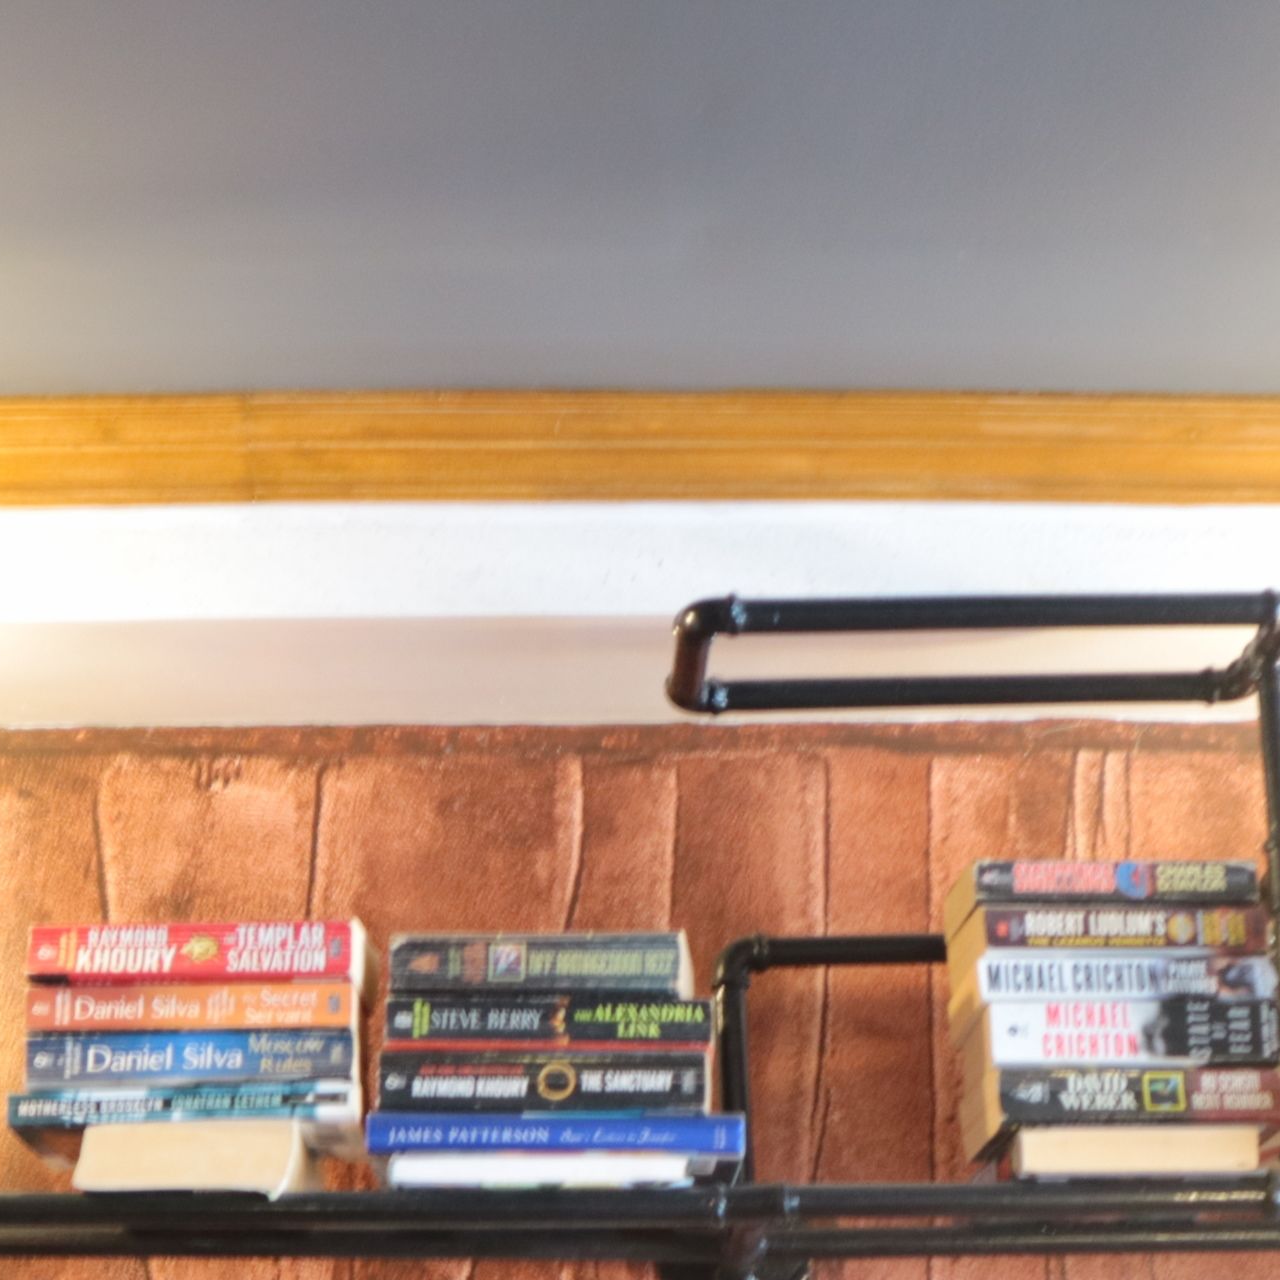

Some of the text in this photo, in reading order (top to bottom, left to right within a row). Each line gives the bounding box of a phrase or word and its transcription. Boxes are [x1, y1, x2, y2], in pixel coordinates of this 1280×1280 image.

[1025, 911, 1167, 936] ROBERT LUDLUM'S
[235, 924, 325, 949] TEMPLAR
[75, 927, 176, 973] RAYMOND KHOURY
[226, 948, 327, 973] SALVATION
[987, 959, 1161, 993] MICHAEL CRICHTON
[74, 994, 145, 1021] Daniel
[152, 994, 200, 1020] Silva
[430, 1007, 482, 1031] STEVE
[487, 1007, 543, 1031] BERRY
[592, 1003, 705, 1024] ALEXANDRIA
[1045, 1002, 1131, 1028] MICHAEL
[617, 1023, 660, 1038] LINK
[1187, 1001, 1211, 1060] STATE
[87, 1042, 172, 1073] Daniel
[183, 1042, 243, 1071] Silva
[1042, 1034, 1138, 1059] CRICHTON
[412, 1075, 531, 1098] RAYMOND KHOURY
[580, 1069, 675, 1093] THE SANCTUARY
[1067, 1069, 1130, 1093] DAVID
[18, 1096, 98, 1118] MOTHERLESS
[1059, 1090, 1138, 1111] WEBER
[387, 1125, 550, 1147] JAMES PATTERSON
